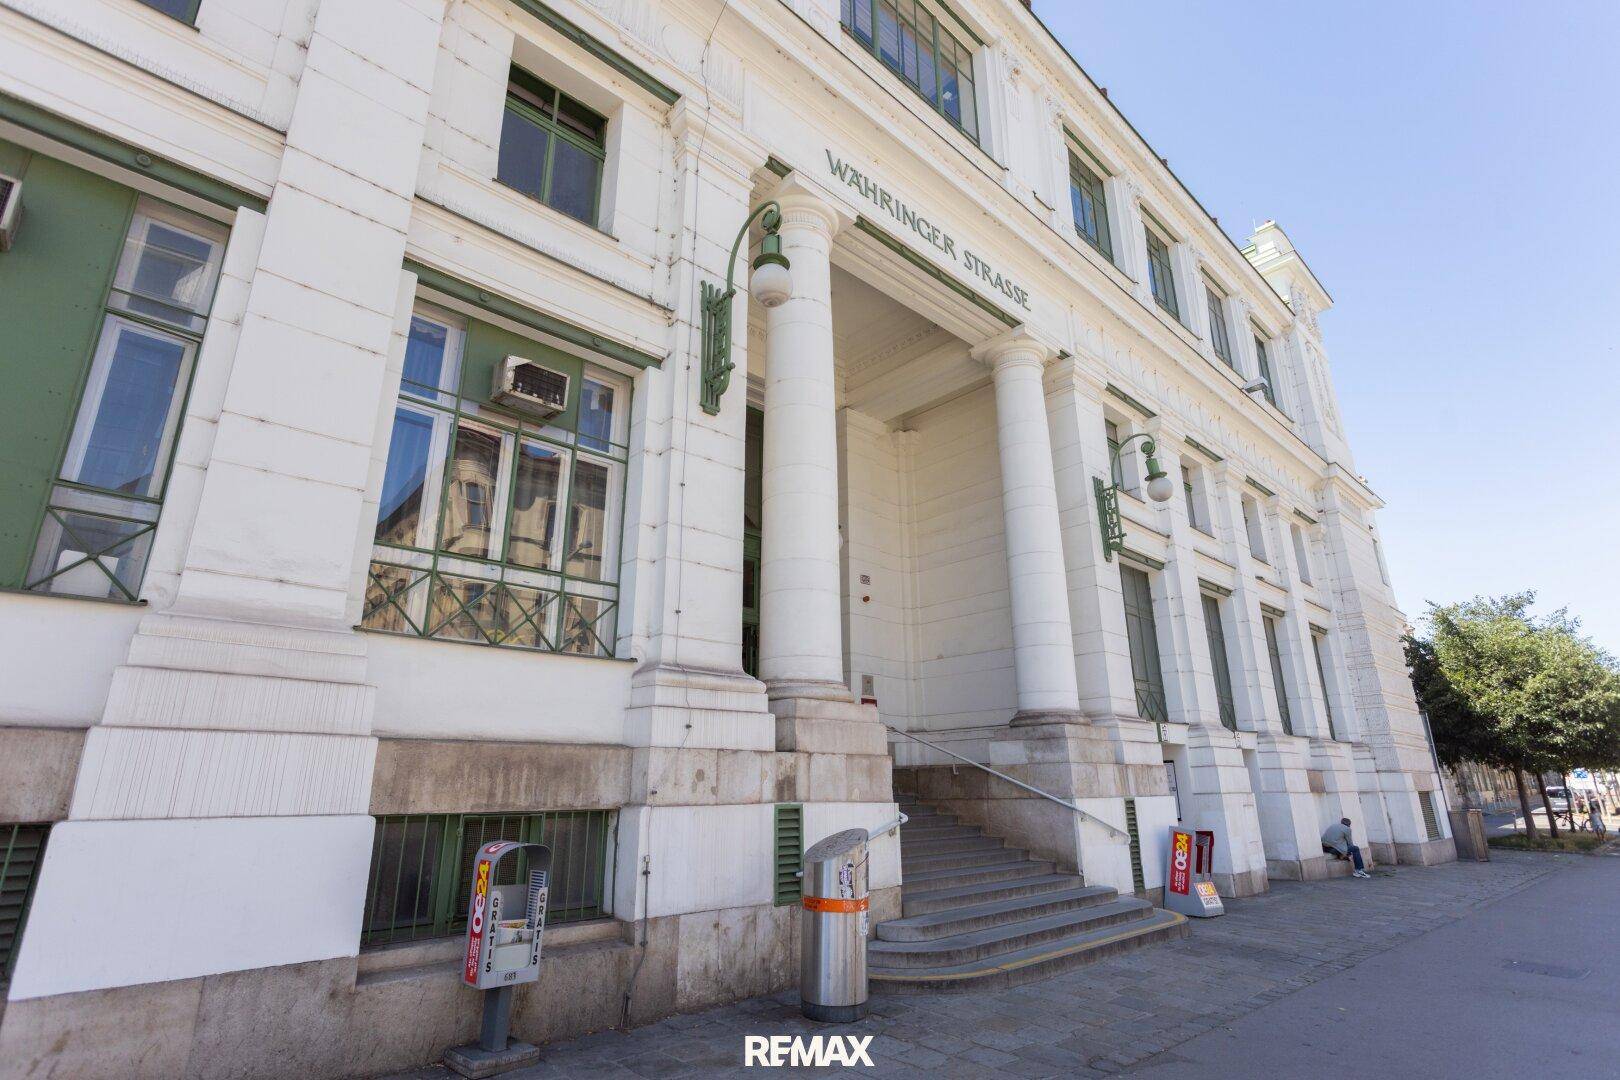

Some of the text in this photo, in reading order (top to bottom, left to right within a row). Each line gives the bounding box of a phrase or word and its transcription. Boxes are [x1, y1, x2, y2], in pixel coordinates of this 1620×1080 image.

[825, 148, 1032, 312] WÄHRINGER STRASSE
[485, 897, 499, 973] GRATIS
[532, 892, 546, 965] GRATIS
